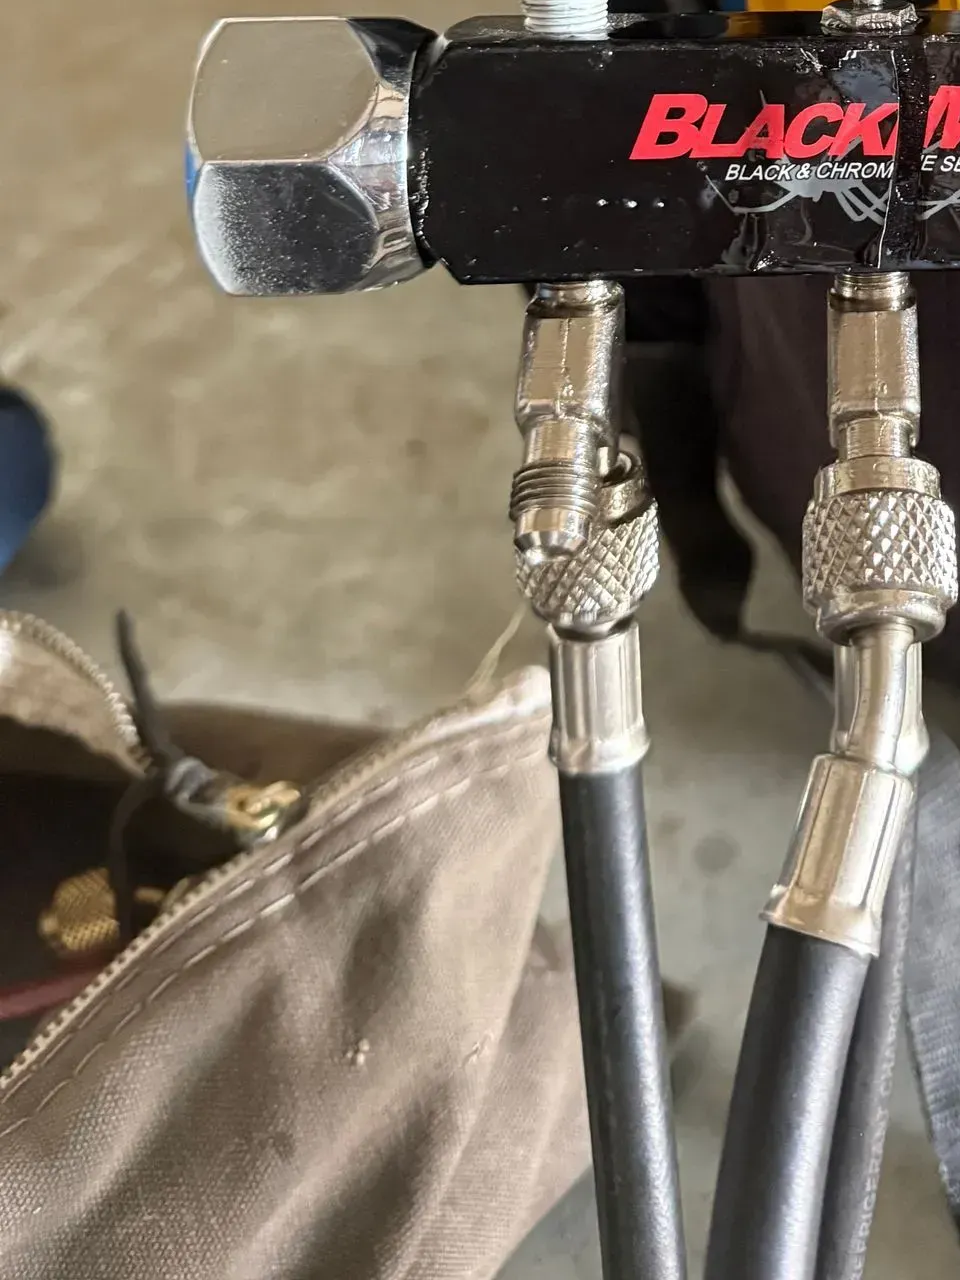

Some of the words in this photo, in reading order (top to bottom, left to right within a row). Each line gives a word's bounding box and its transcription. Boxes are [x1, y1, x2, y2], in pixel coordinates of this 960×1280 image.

[629, 94, 900, 160] BLACK
[725, 163, 795, 181] BLACK
[798, 163, 811, 180] &
